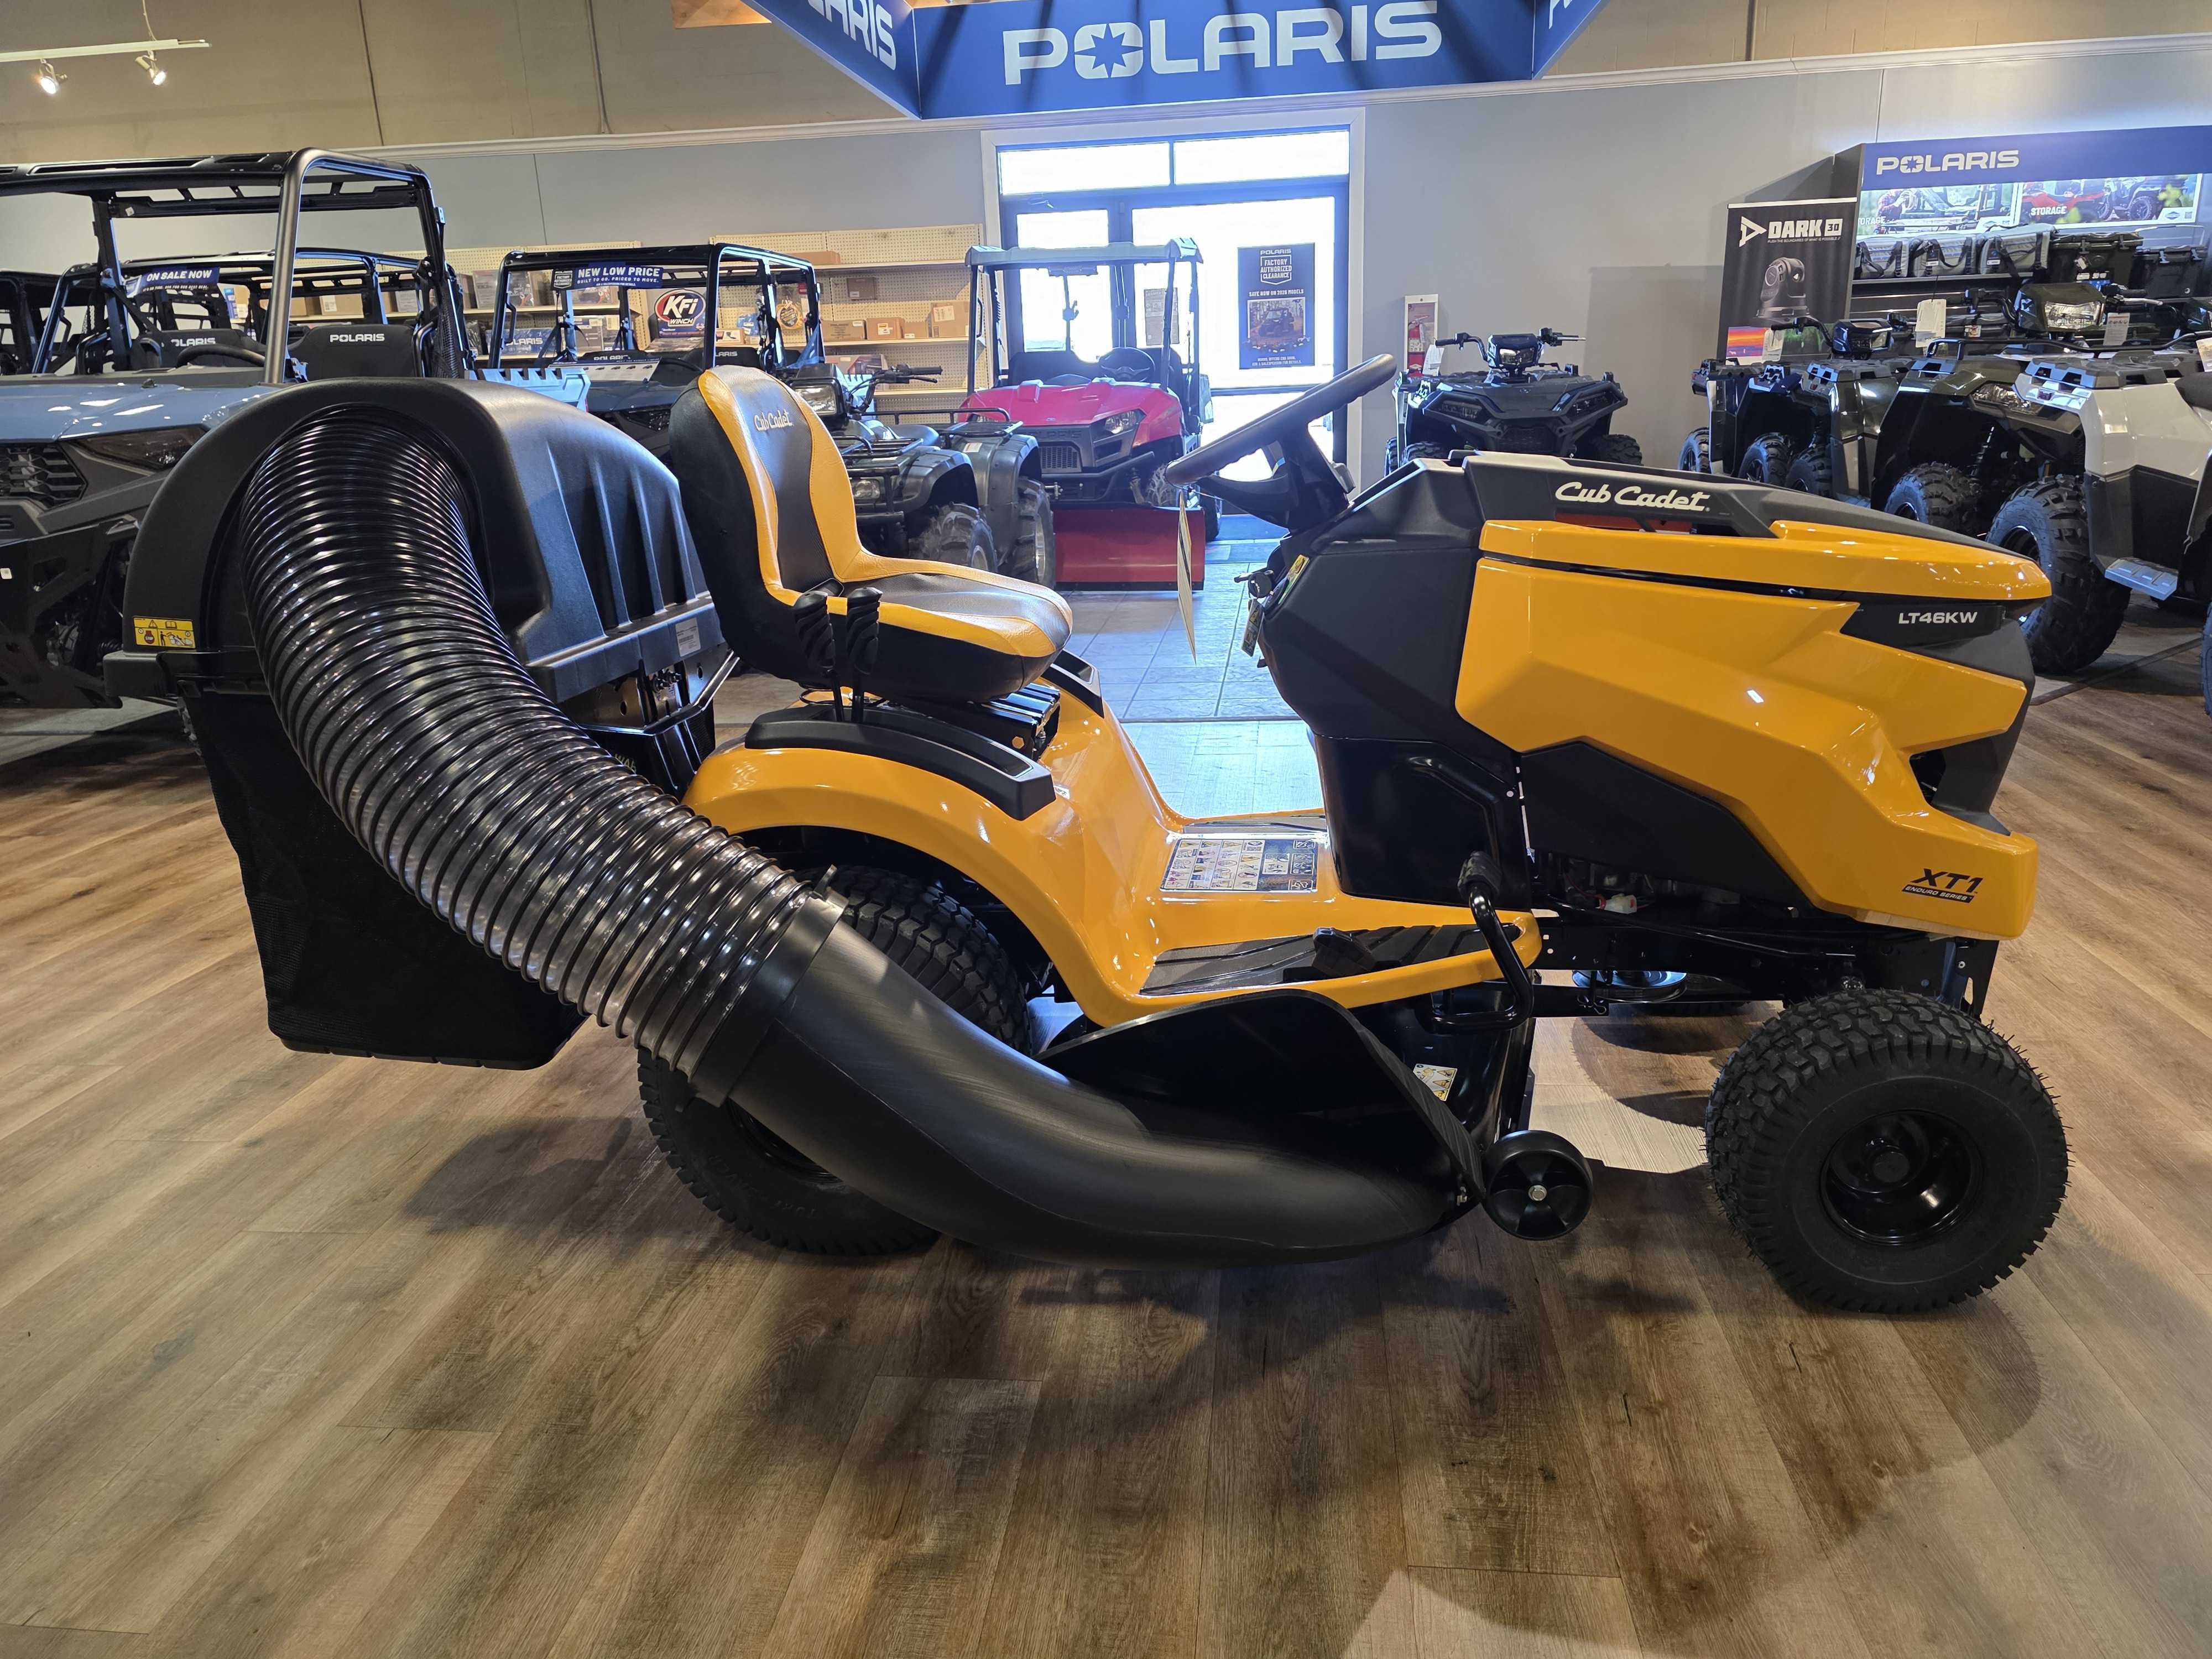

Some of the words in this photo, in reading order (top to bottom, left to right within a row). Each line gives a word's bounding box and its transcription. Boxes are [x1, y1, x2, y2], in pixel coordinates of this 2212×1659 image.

[808, 0, 896, 70] ARIS
[1003, 1, 1442, 85] POLARIS
[1876, 150, 2018, 175] POLARIS
[2030, 206, 2067, 216] STORAGE
[1858, 216, 1886, 225] ORAGE
[1768, 220, 1823, 239] DARK
[1827, 223, 1839, 232] 30
[146, 273, 160, 281] ON
[160, 270, 187, 280] SALE
[188, 269, 212, 279] NOW
[578, 268, 601, 278] NEW
[603, 267, 626, 276] LOW
[628, 267, 661, 276] PRICE
[170, 337, 216, 347] OLARIS
[330, 333, 385, 342] POLARIS
[506, 337, 543, 346] LARIS
[754, 412, 769, 431] Cub
[768, 409, 792, 429] Cadet
[1555, 482, 1611, 503] Cub
[1614, 486, 1711, 512] Cadet
[1898, 612, 1978, 624] LT46KW
[1910, 868, 1984, 893] XT1
[1905, 886, 1938, 895] ENDURO
[1940, 892, 1968, 900] SERIES
